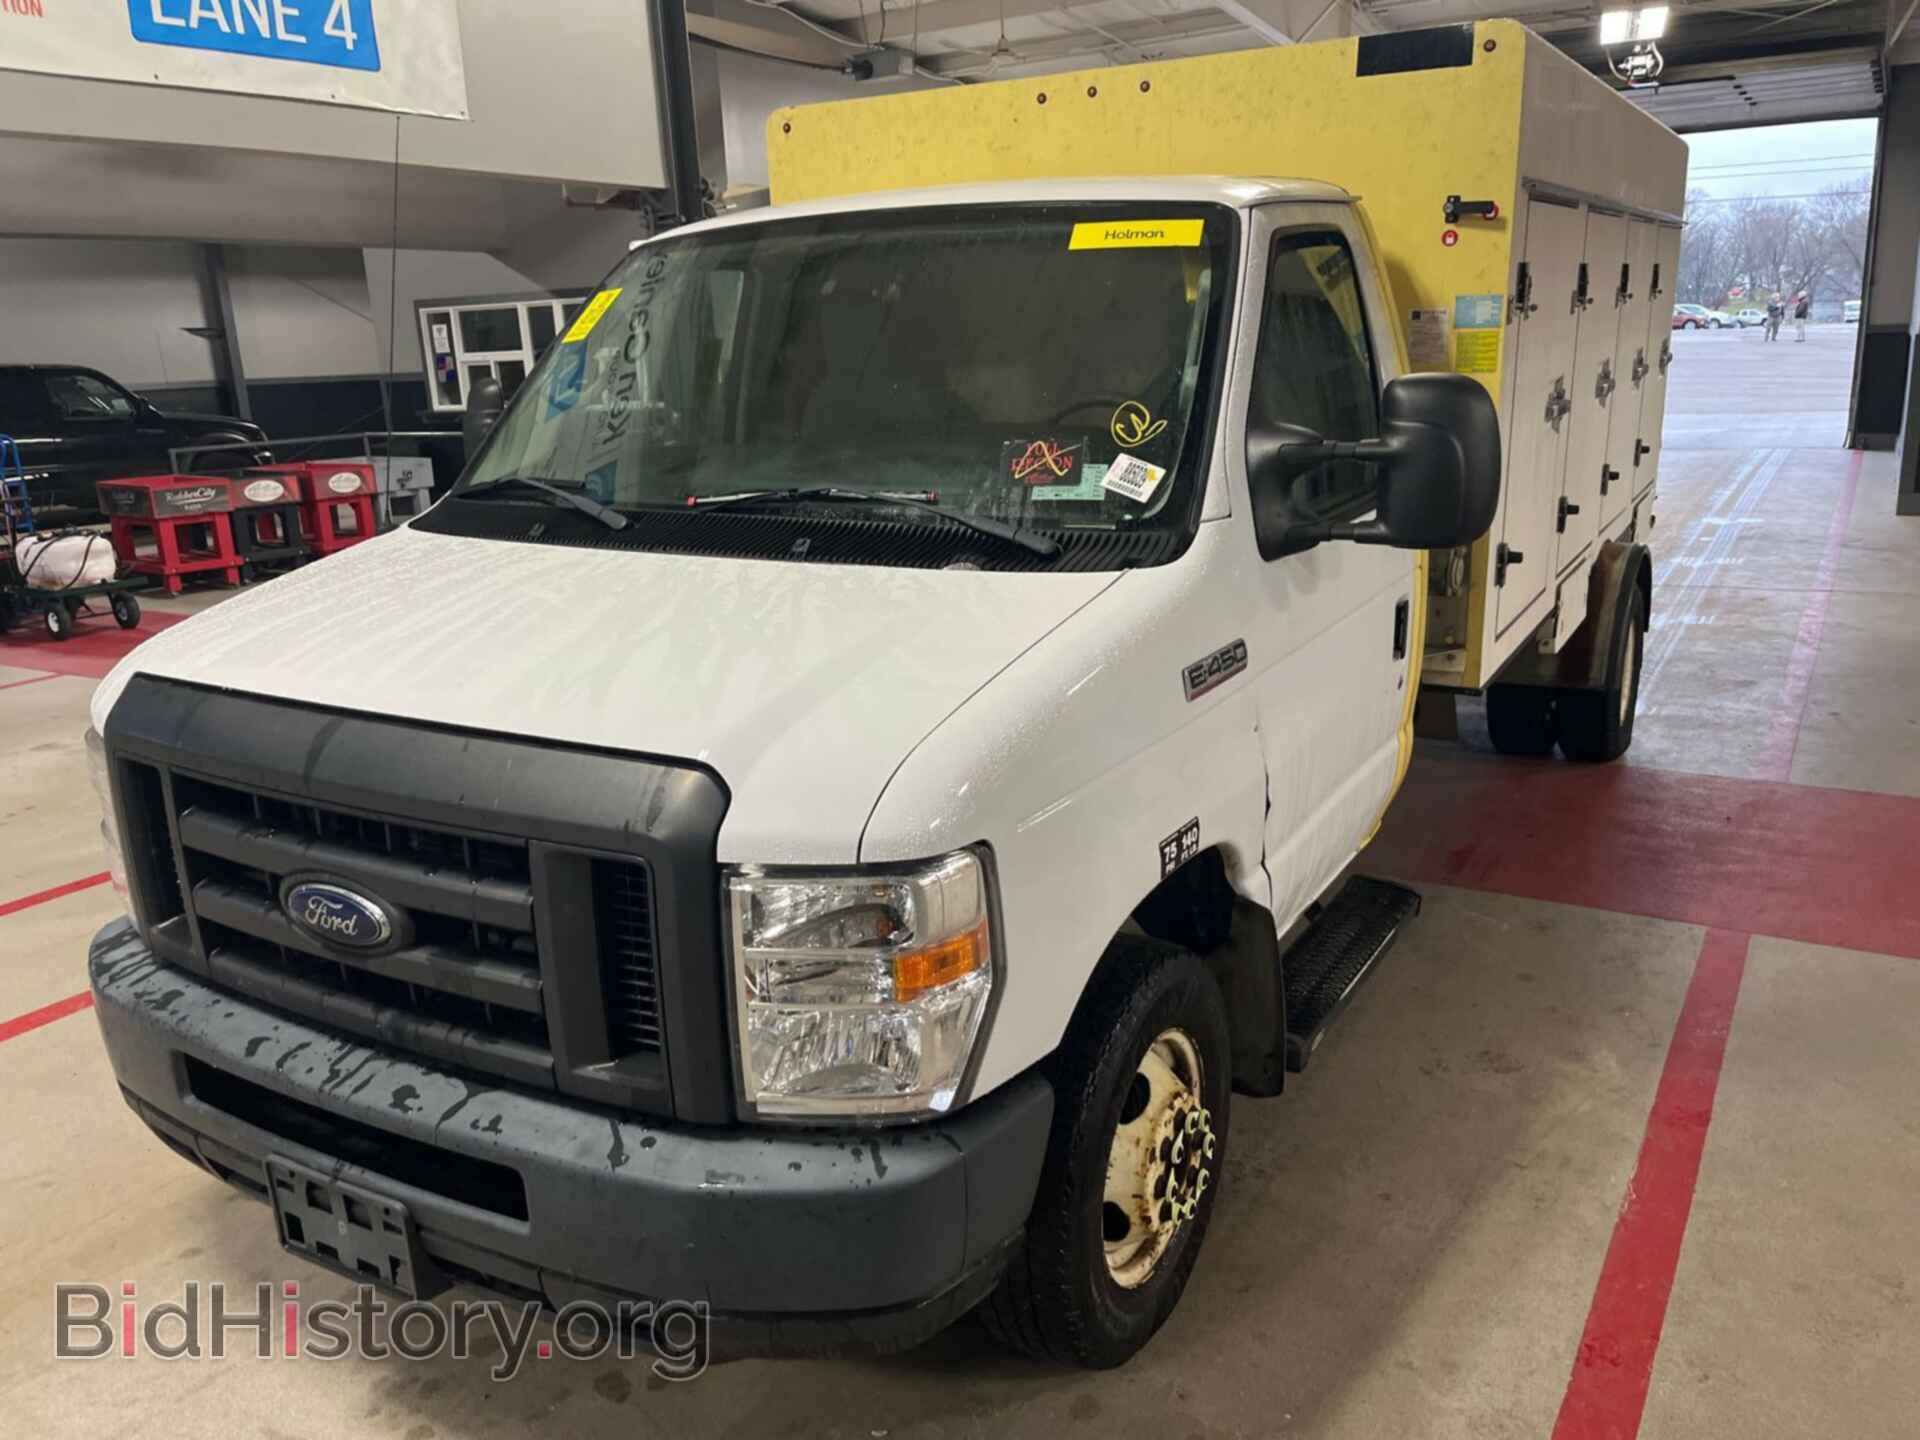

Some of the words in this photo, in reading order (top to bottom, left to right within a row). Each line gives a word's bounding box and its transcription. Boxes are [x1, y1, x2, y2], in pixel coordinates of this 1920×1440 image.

[151, 0, 307, 43] LANE
[323, 0, 357, 50] 4
[1104, 229, 1165, 240] Holman
[1163, 841, 1177, 863] 75
[305, 896, 359, 936] Ford
